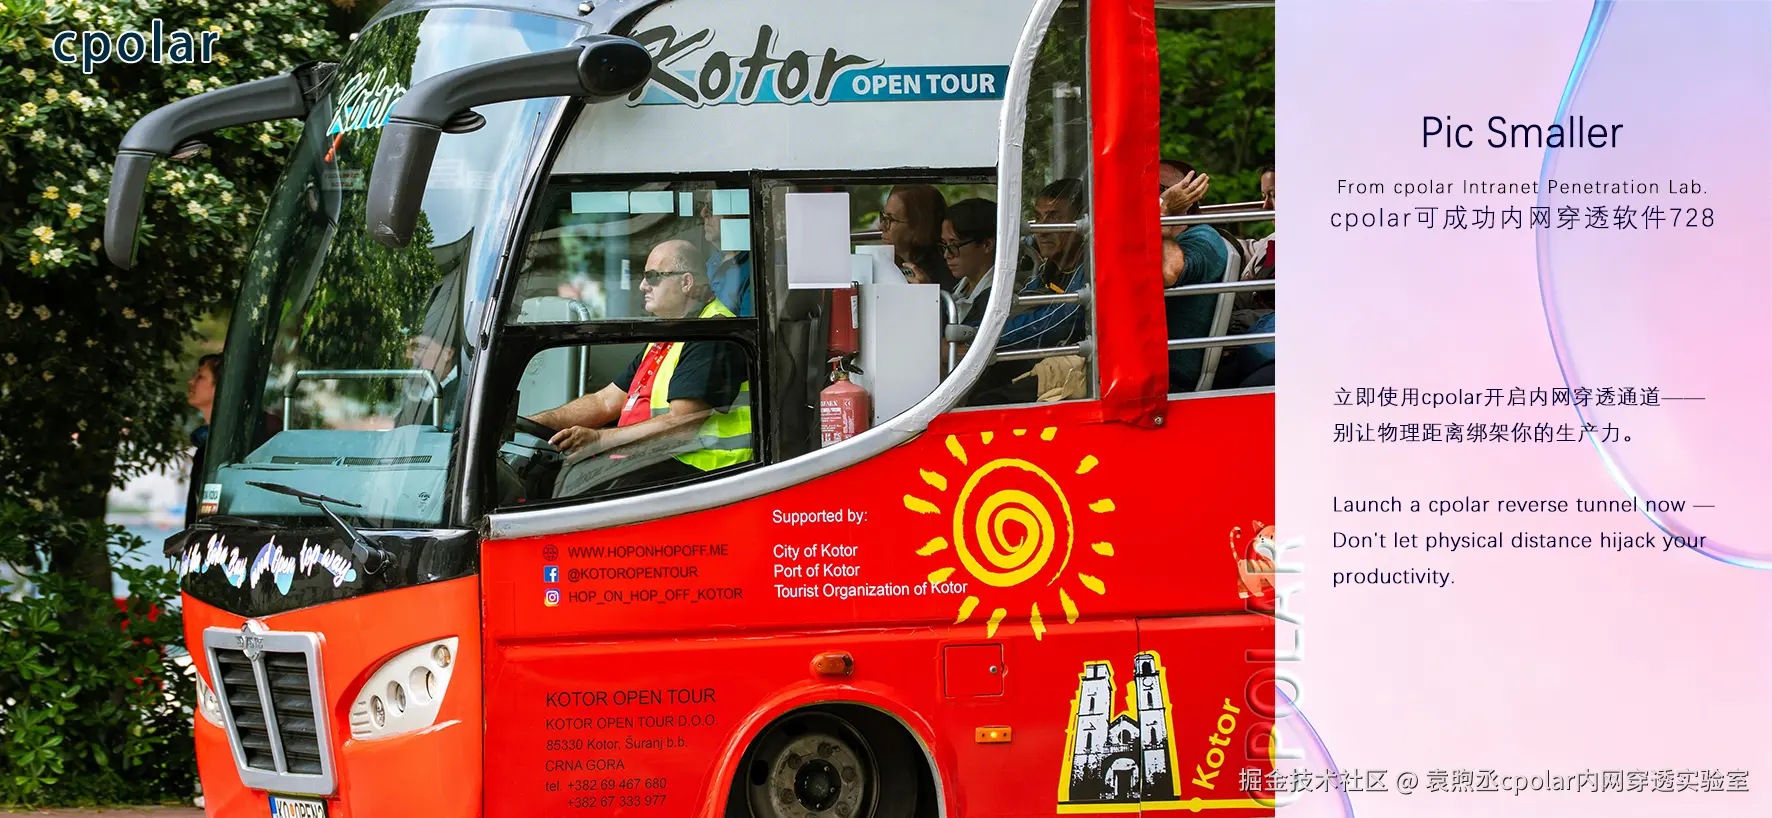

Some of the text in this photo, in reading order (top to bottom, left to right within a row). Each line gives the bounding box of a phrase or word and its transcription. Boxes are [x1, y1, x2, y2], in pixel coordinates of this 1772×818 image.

[626, 24, 996, 108] Kotor OPEN TOUR
[772, 508, 868, 526] Supported by:
[567, 544, 729, 558] WWW.HOPONHOPOFF.ME
[773, 543, 858, 560] City of Kotor
[300, 538, 321, 577] top
[321, 549, 352, 588] way
[774, 563, 860, 578] Port of Kotor
[567, 566, 698, 583] @KOTOROPENTOUR
[568, 588, 743, 605] HOP_ON_HOP_OFF_KOTOR
[774, 580, 968, 600] Tourist Organization of Kotor
[546, 688, 716, 707] KOTOR OPEN TOUR
[545, 714, 719, 731] KOTOR OPEN TOUR D.O.O.
[546, 735, 688, 751] 85330 Kotor, Šuranj b.b.
[1192, 697, 1241, 790] Kotor
[545, 759, 625, 772] CRNA GORA
[545, 777, 667, 792] tel. +382 69 467 680
[567, 794, 667, 808] +382 67 333 977
